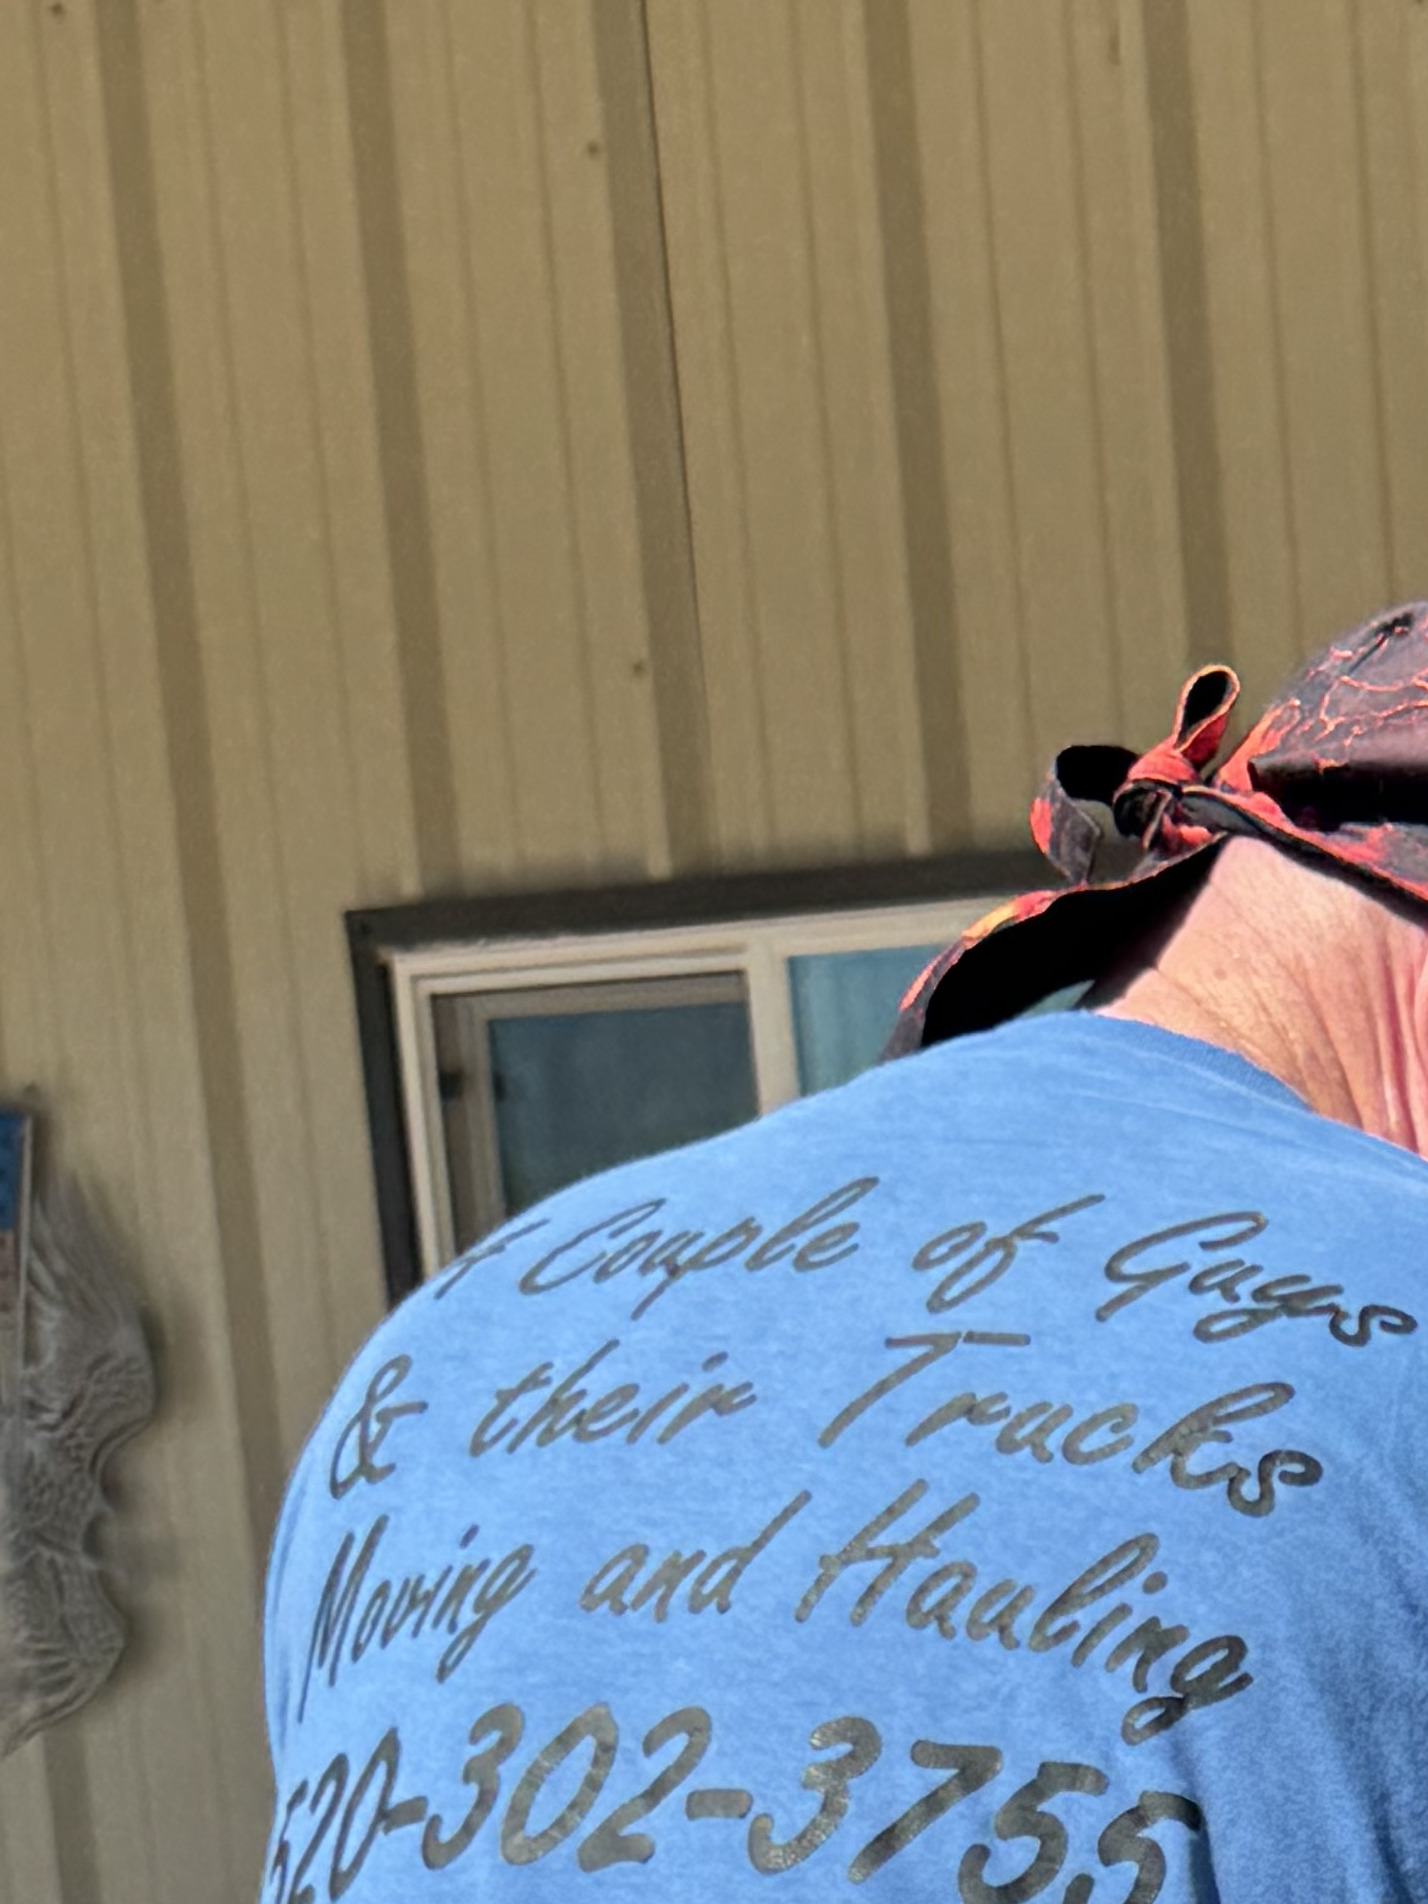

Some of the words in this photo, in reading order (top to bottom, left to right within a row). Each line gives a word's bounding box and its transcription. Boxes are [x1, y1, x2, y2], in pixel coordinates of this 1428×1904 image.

[518, 1176, 879, 1320] Couple
[911, 1194, 1106, 1314] of
[1096, 1213, 1417, 1347] Guys
[330, 1356, 427, 1498] &
[469, 1339, 757, 1457] their
[818, 1331, 1323, 1517] Trucks
[297, 1514, 536, 1723] Moving
[583, 1491, 810, 1614] and
[795, 1478, 1255, 1747] Hauling
